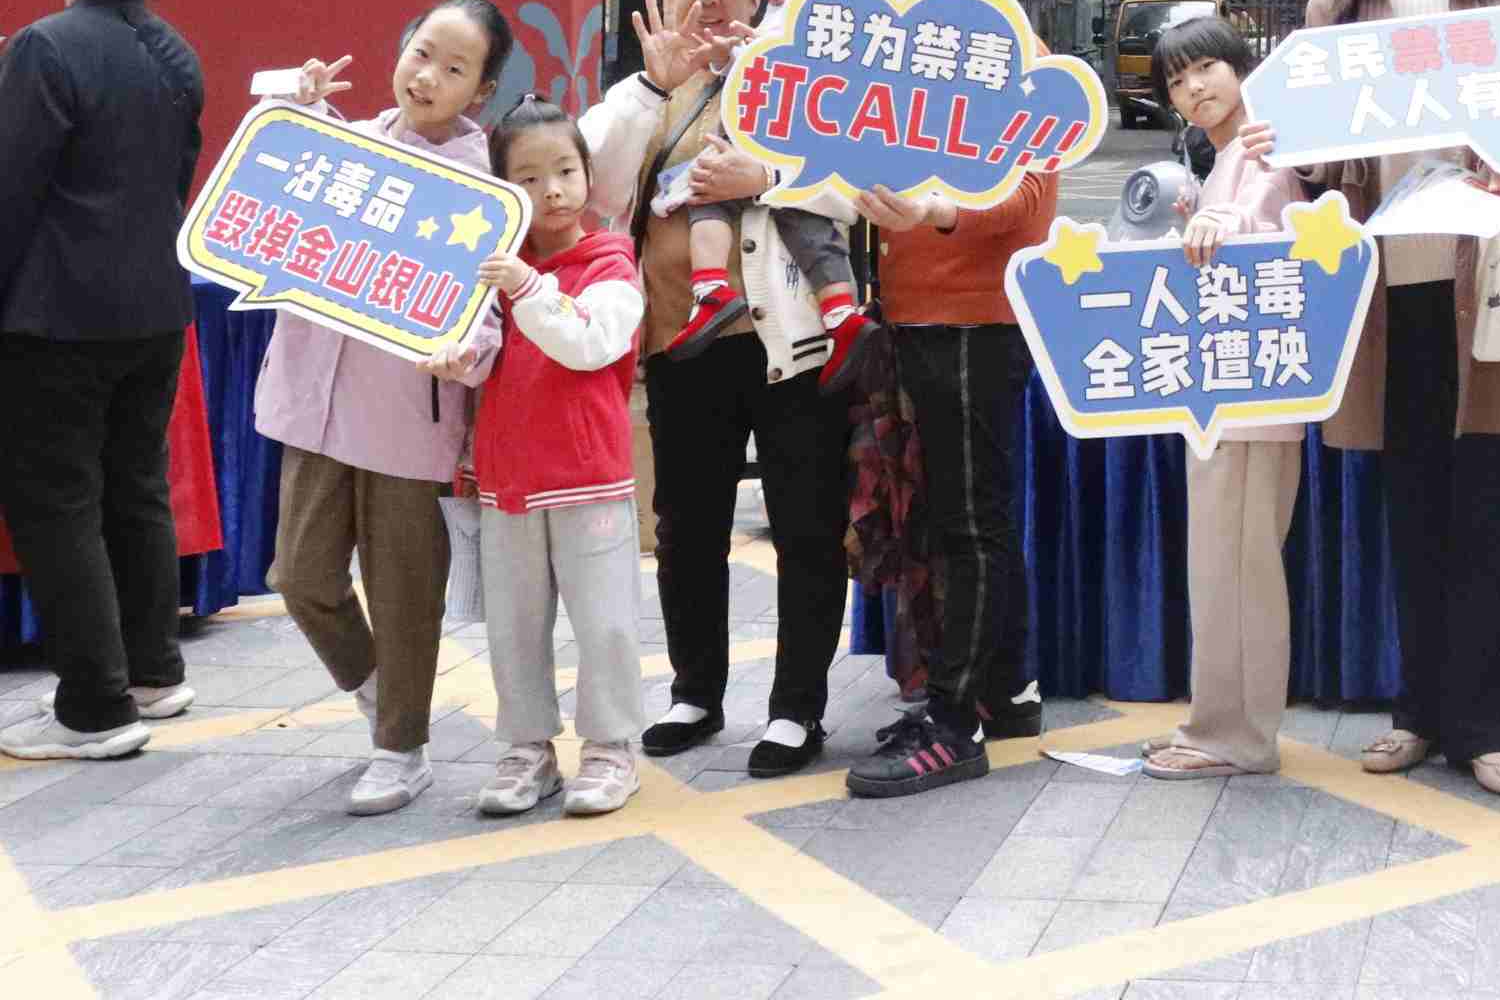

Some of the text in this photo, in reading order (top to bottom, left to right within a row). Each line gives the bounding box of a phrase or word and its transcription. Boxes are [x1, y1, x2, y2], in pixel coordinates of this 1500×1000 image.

[805, 3, 1013, 91] 我为禁毒
[1282, 19, 1497, 89] 全民禁毒
[255, 151, 414, 233] 一沾毒品
[204, 191, 463, 330] 毁掉金山银山
[1079, 258, 1306, 328] 一人染毒
[1083, 327, 1312, 400] 全家遭殃
